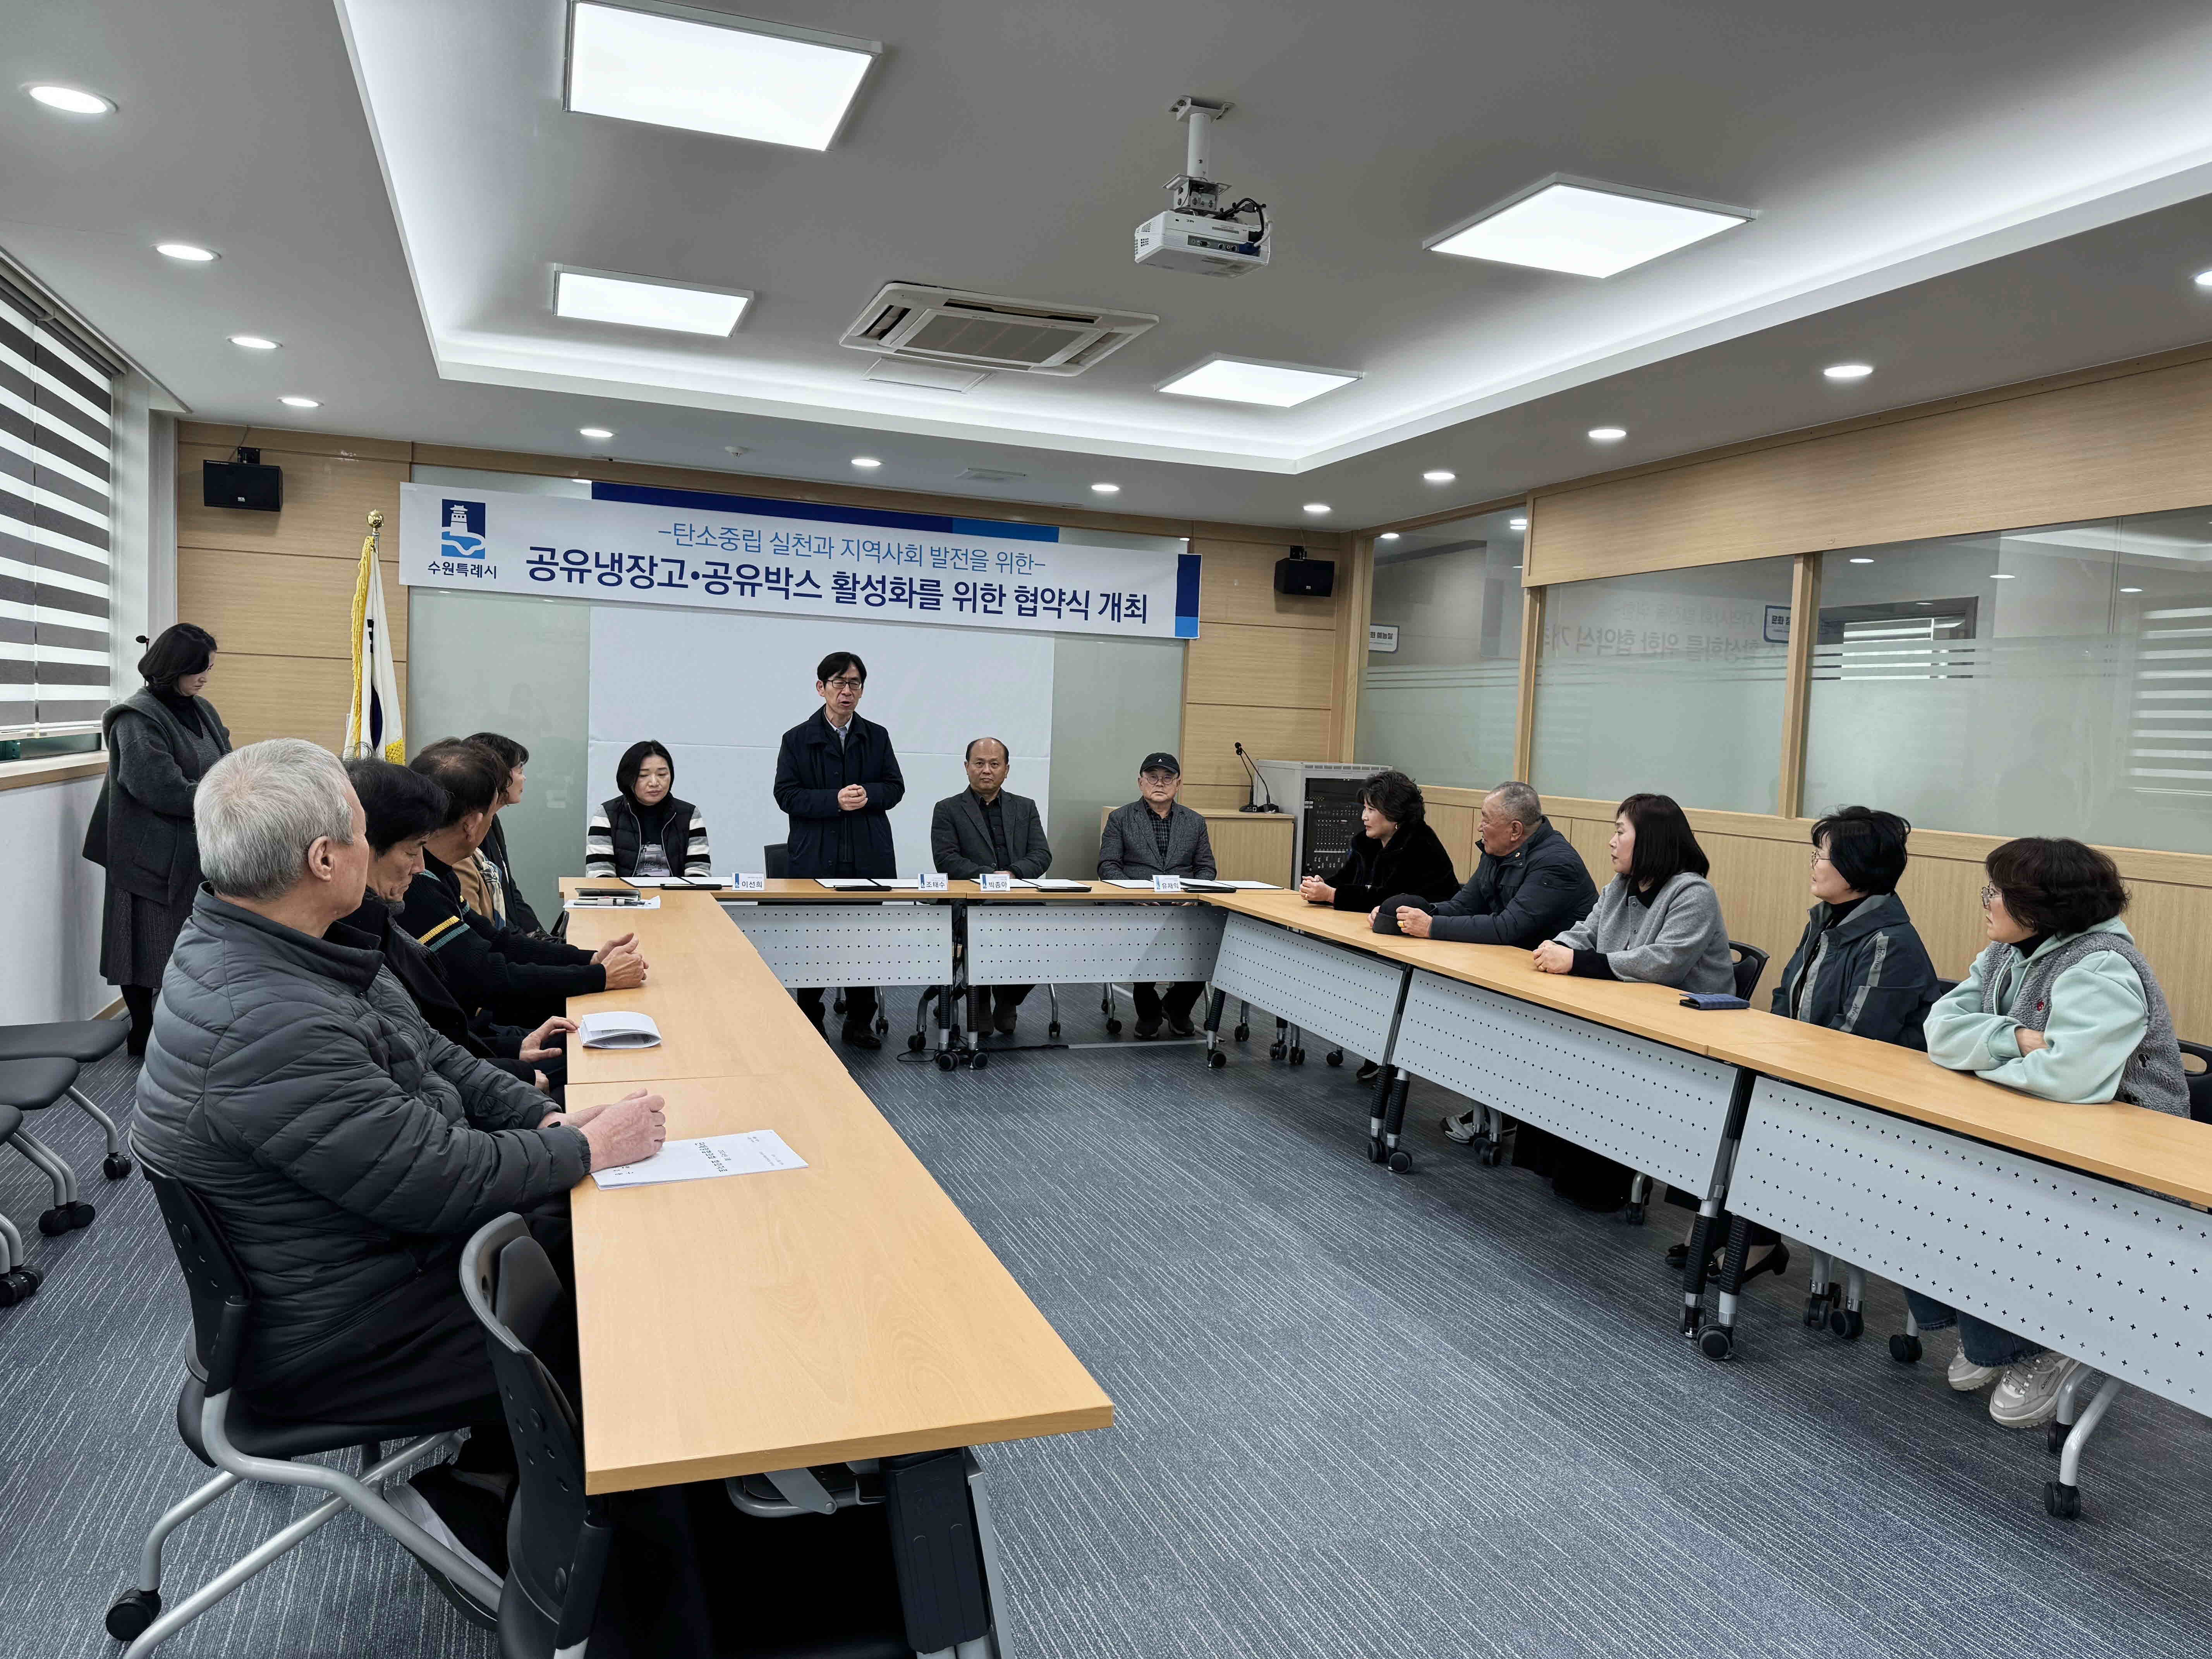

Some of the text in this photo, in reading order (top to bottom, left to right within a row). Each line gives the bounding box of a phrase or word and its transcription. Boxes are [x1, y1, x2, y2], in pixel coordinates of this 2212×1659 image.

[428, 560, 496, 579] 수원특례시
[659, 523, 1045, 576] -탄소중립 실천과 지역사회 발전을 위한-
[526, 546, 1147, 625] 공유냉장고·공유박스 활성화를 위한 협약식 개최
